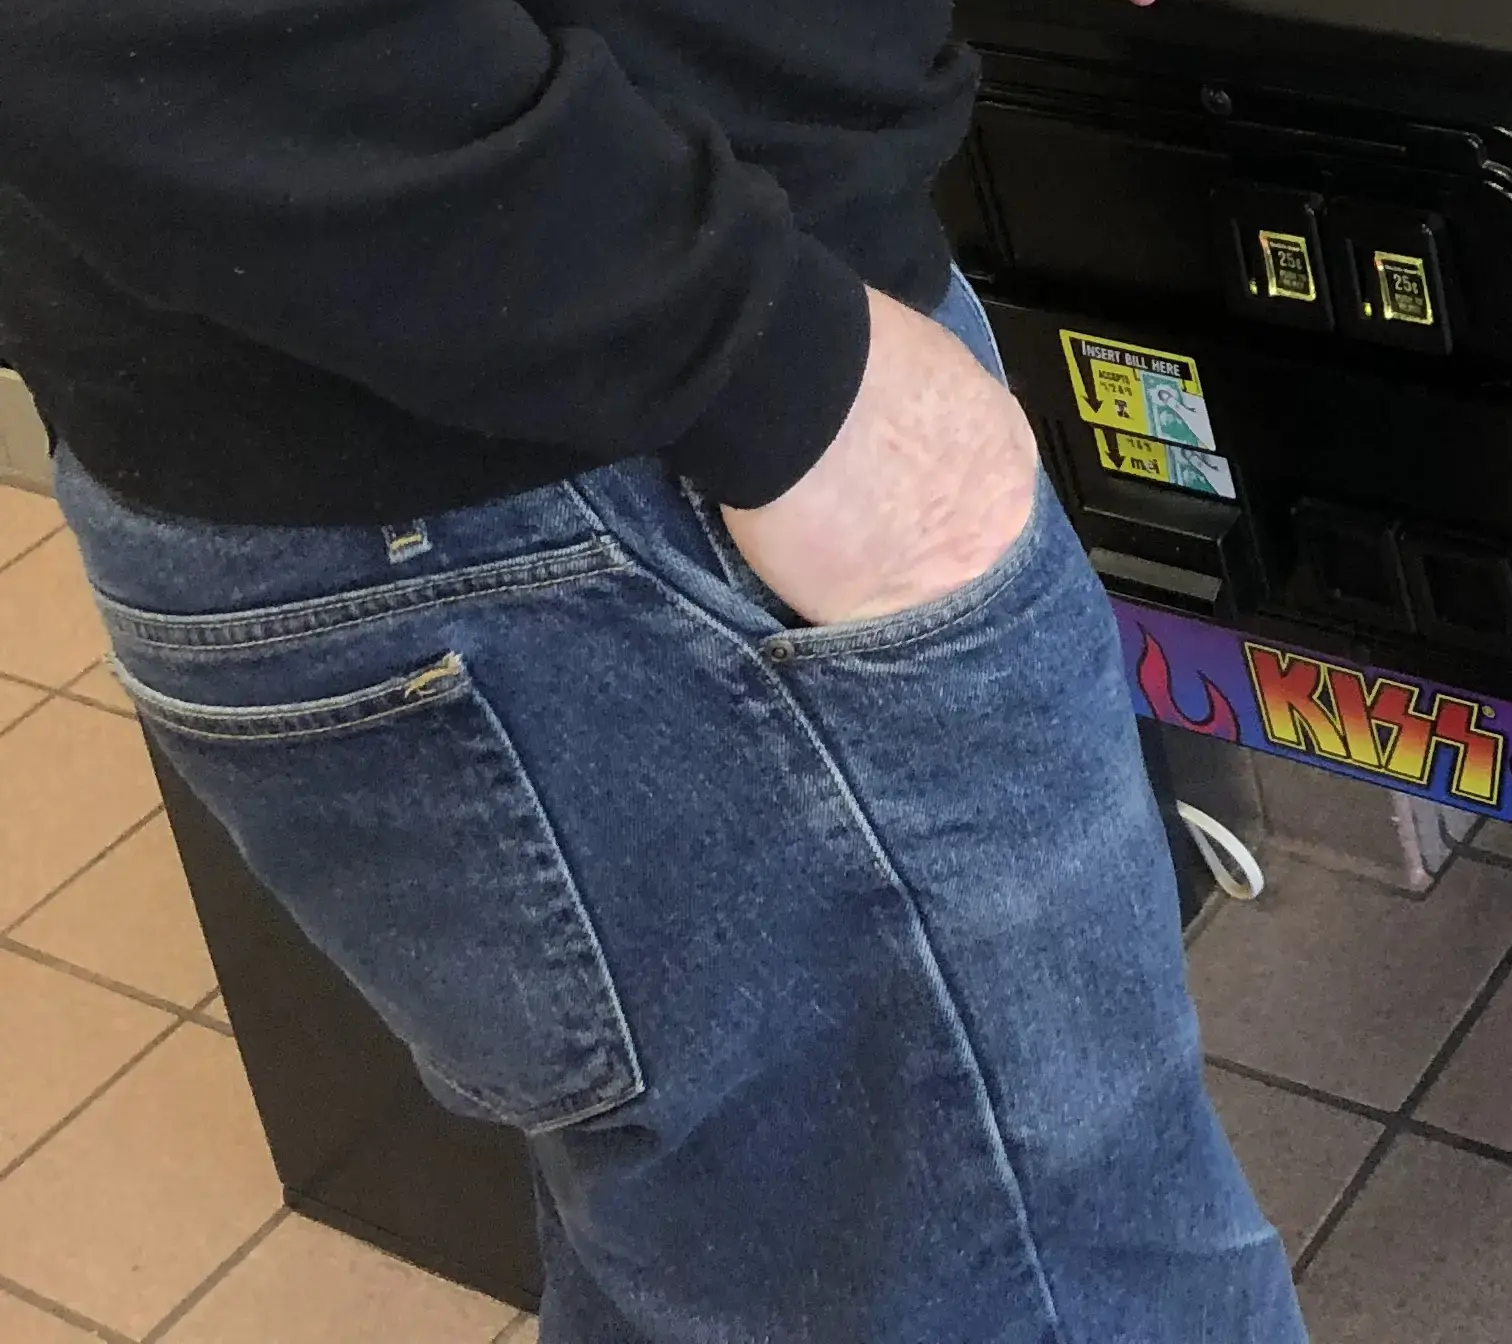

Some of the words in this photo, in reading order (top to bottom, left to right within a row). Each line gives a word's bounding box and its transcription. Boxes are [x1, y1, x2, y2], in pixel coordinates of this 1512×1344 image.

[1081, 340, 1121, 363] INSERT
[1125, 352, 1148, 370] BILL
[1151, 359, 1181, 377] HERE
[1244, 641, 1504, 806] KISS
